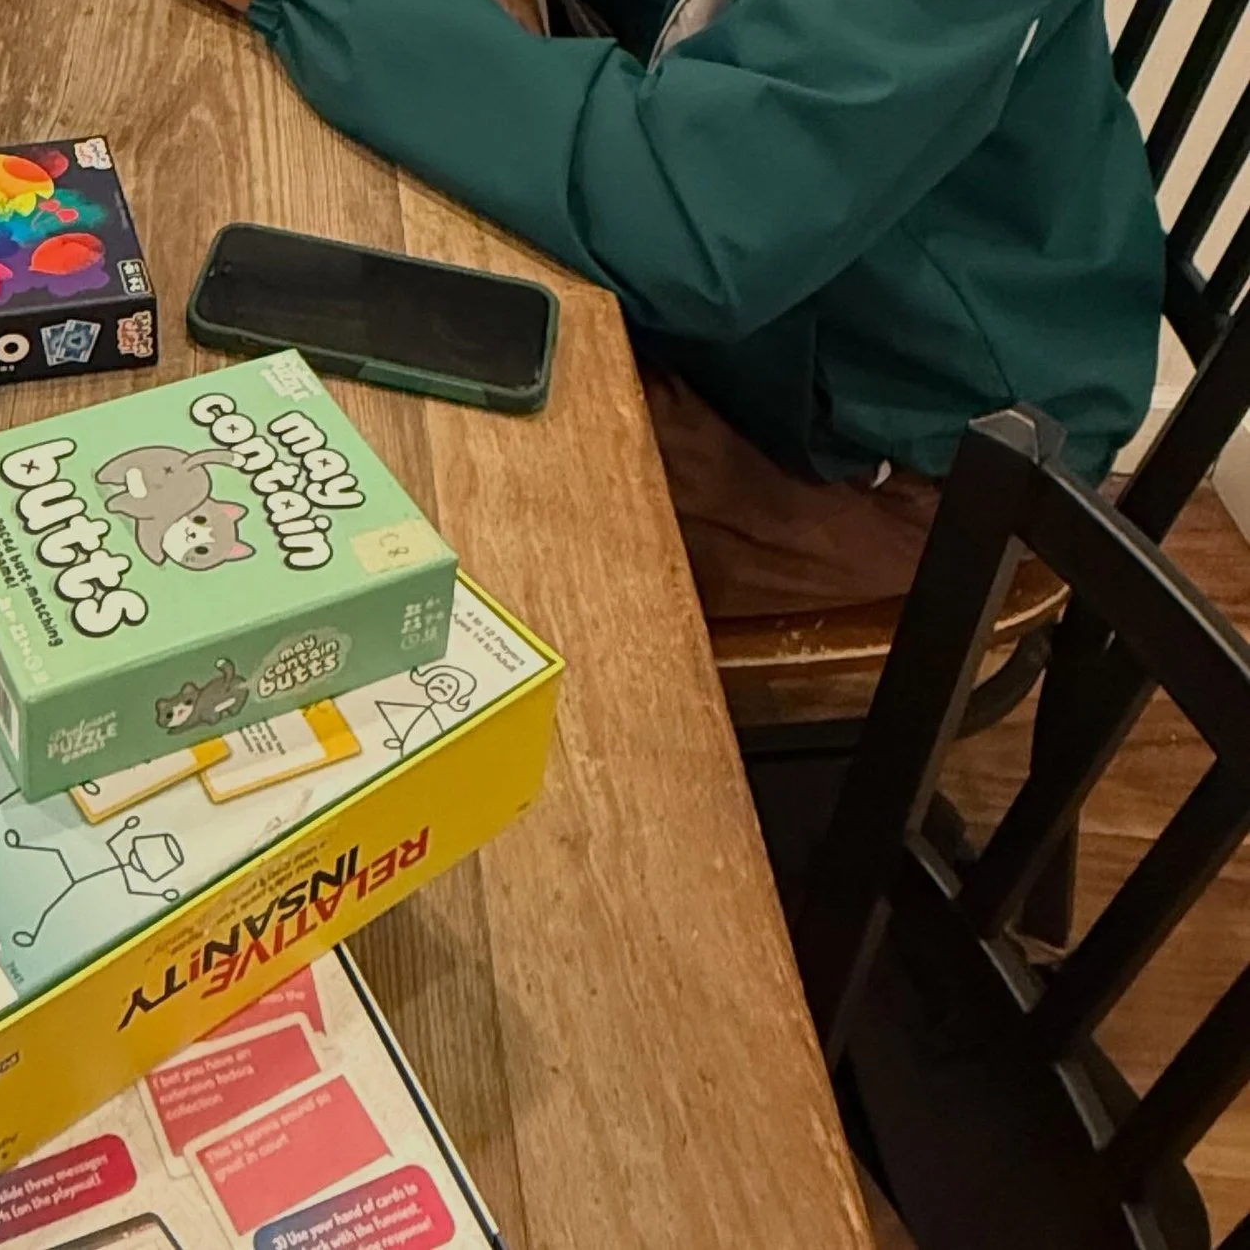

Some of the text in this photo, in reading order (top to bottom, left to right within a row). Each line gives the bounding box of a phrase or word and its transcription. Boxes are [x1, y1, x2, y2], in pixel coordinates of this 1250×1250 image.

[189, 392, 334, 570] contain
[266, 408, 366, 511] may
[9, 553, 63, 648] butt-matching
[264, 639, 339, 681] contain
[279, 634, 316, 662] may
[257, 652, 338, 698] butts
[201, 826, 431, 999] RELATIVE
[181, 1065, 205, 1086] you
[26, 1173, 53, 1197] three
[30, 1192, 52, 1210] the
[309, 1220, 335, 1243] your
[333, 1205, 363, 1227] hand
[403, 1183, 418, 1197] to
[352, 1220, 374, 1240] the
